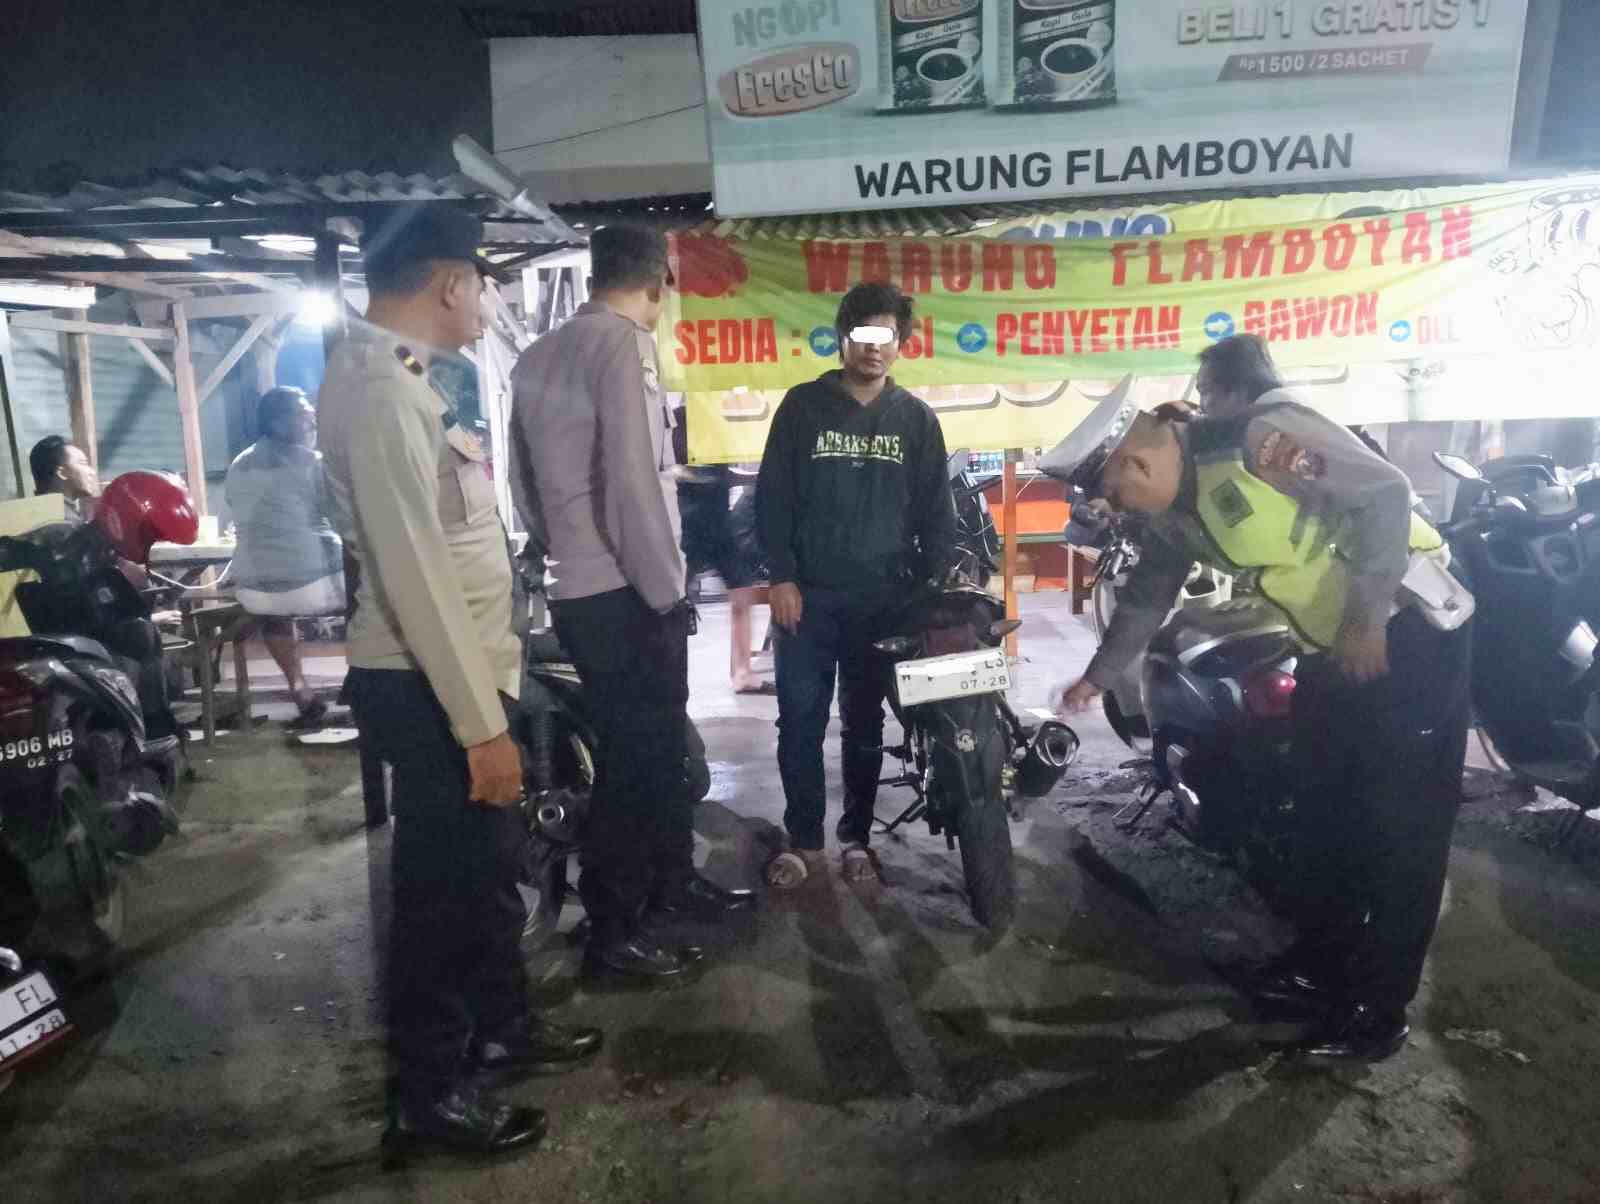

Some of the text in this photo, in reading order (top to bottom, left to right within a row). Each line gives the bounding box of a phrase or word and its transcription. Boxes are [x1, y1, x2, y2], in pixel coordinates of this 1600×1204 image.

[1177, 3, 1265, 44] BELI
[1332, 49, 1409, 69] SACHET
[854, 132, 1354, 199] WARUNG FLAMBOYAN
[803, 205, 1473, 294] WARUNG FLAMBOYAN
[674, 319, 779, 364] SEDIA
[996, 306, 1182, 357] PENYETAN
[1242, 292, 1379, 346] RAWON
[47, 728, 74, 749] MB
[14, 984, 52, 1014] FL
